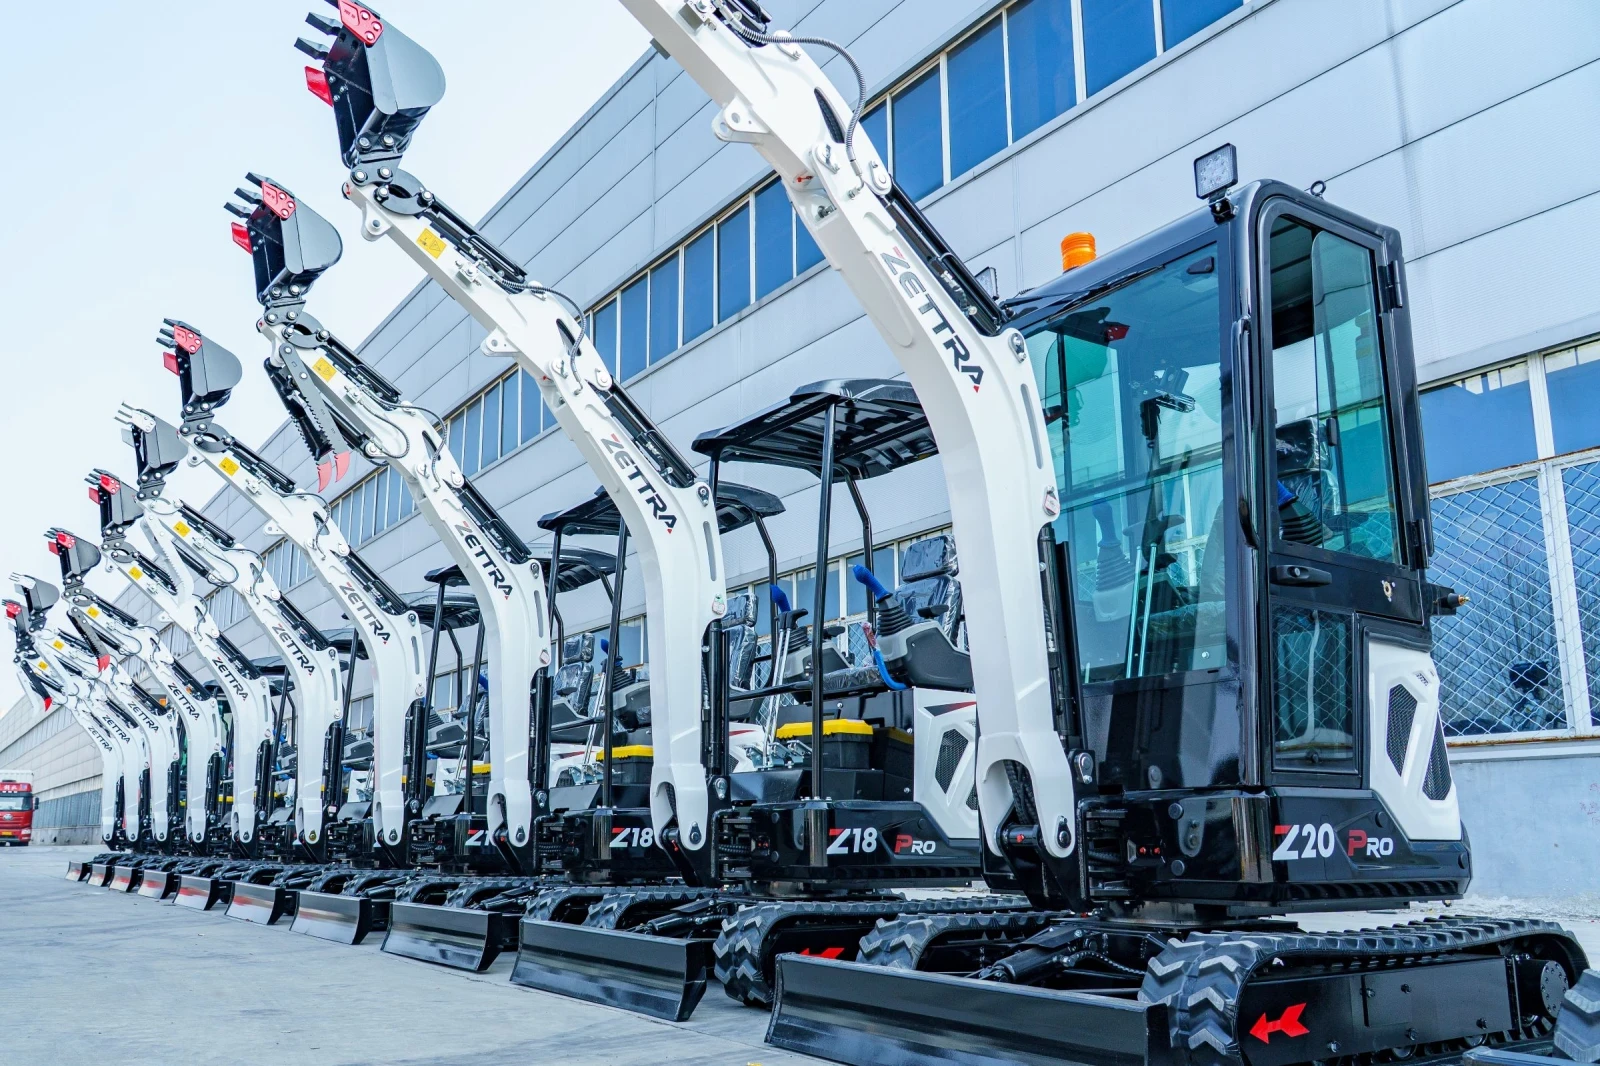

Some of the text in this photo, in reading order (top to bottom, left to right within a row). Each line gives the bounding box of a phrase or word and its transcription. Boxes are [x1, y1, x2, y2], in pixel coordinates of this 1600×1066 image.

[880, 246, 984, 393] ZETTRA
[600, 433, 677, 534] ZETTRA
[454, 520, 513, 600] ZETTRA
[339, 582, 391, 644] ZETTRA
[272, 623, 315, 676] ZETTRA
[211, 656, 249, 701] ZETTRA
[127, 700, 159, 735] ZETTRA
[167, 682, 200, 721] ZETTRA
[87, 725, 113, 752] ZETTRA
[101, 714, 130, 744] ZETTRA
[464, 829, 490, 846] Z1
[609, 827, 653, 848] Z18
[826, 826, 878, 855] Z18
[1272, 822, 1335, 861] Z20
